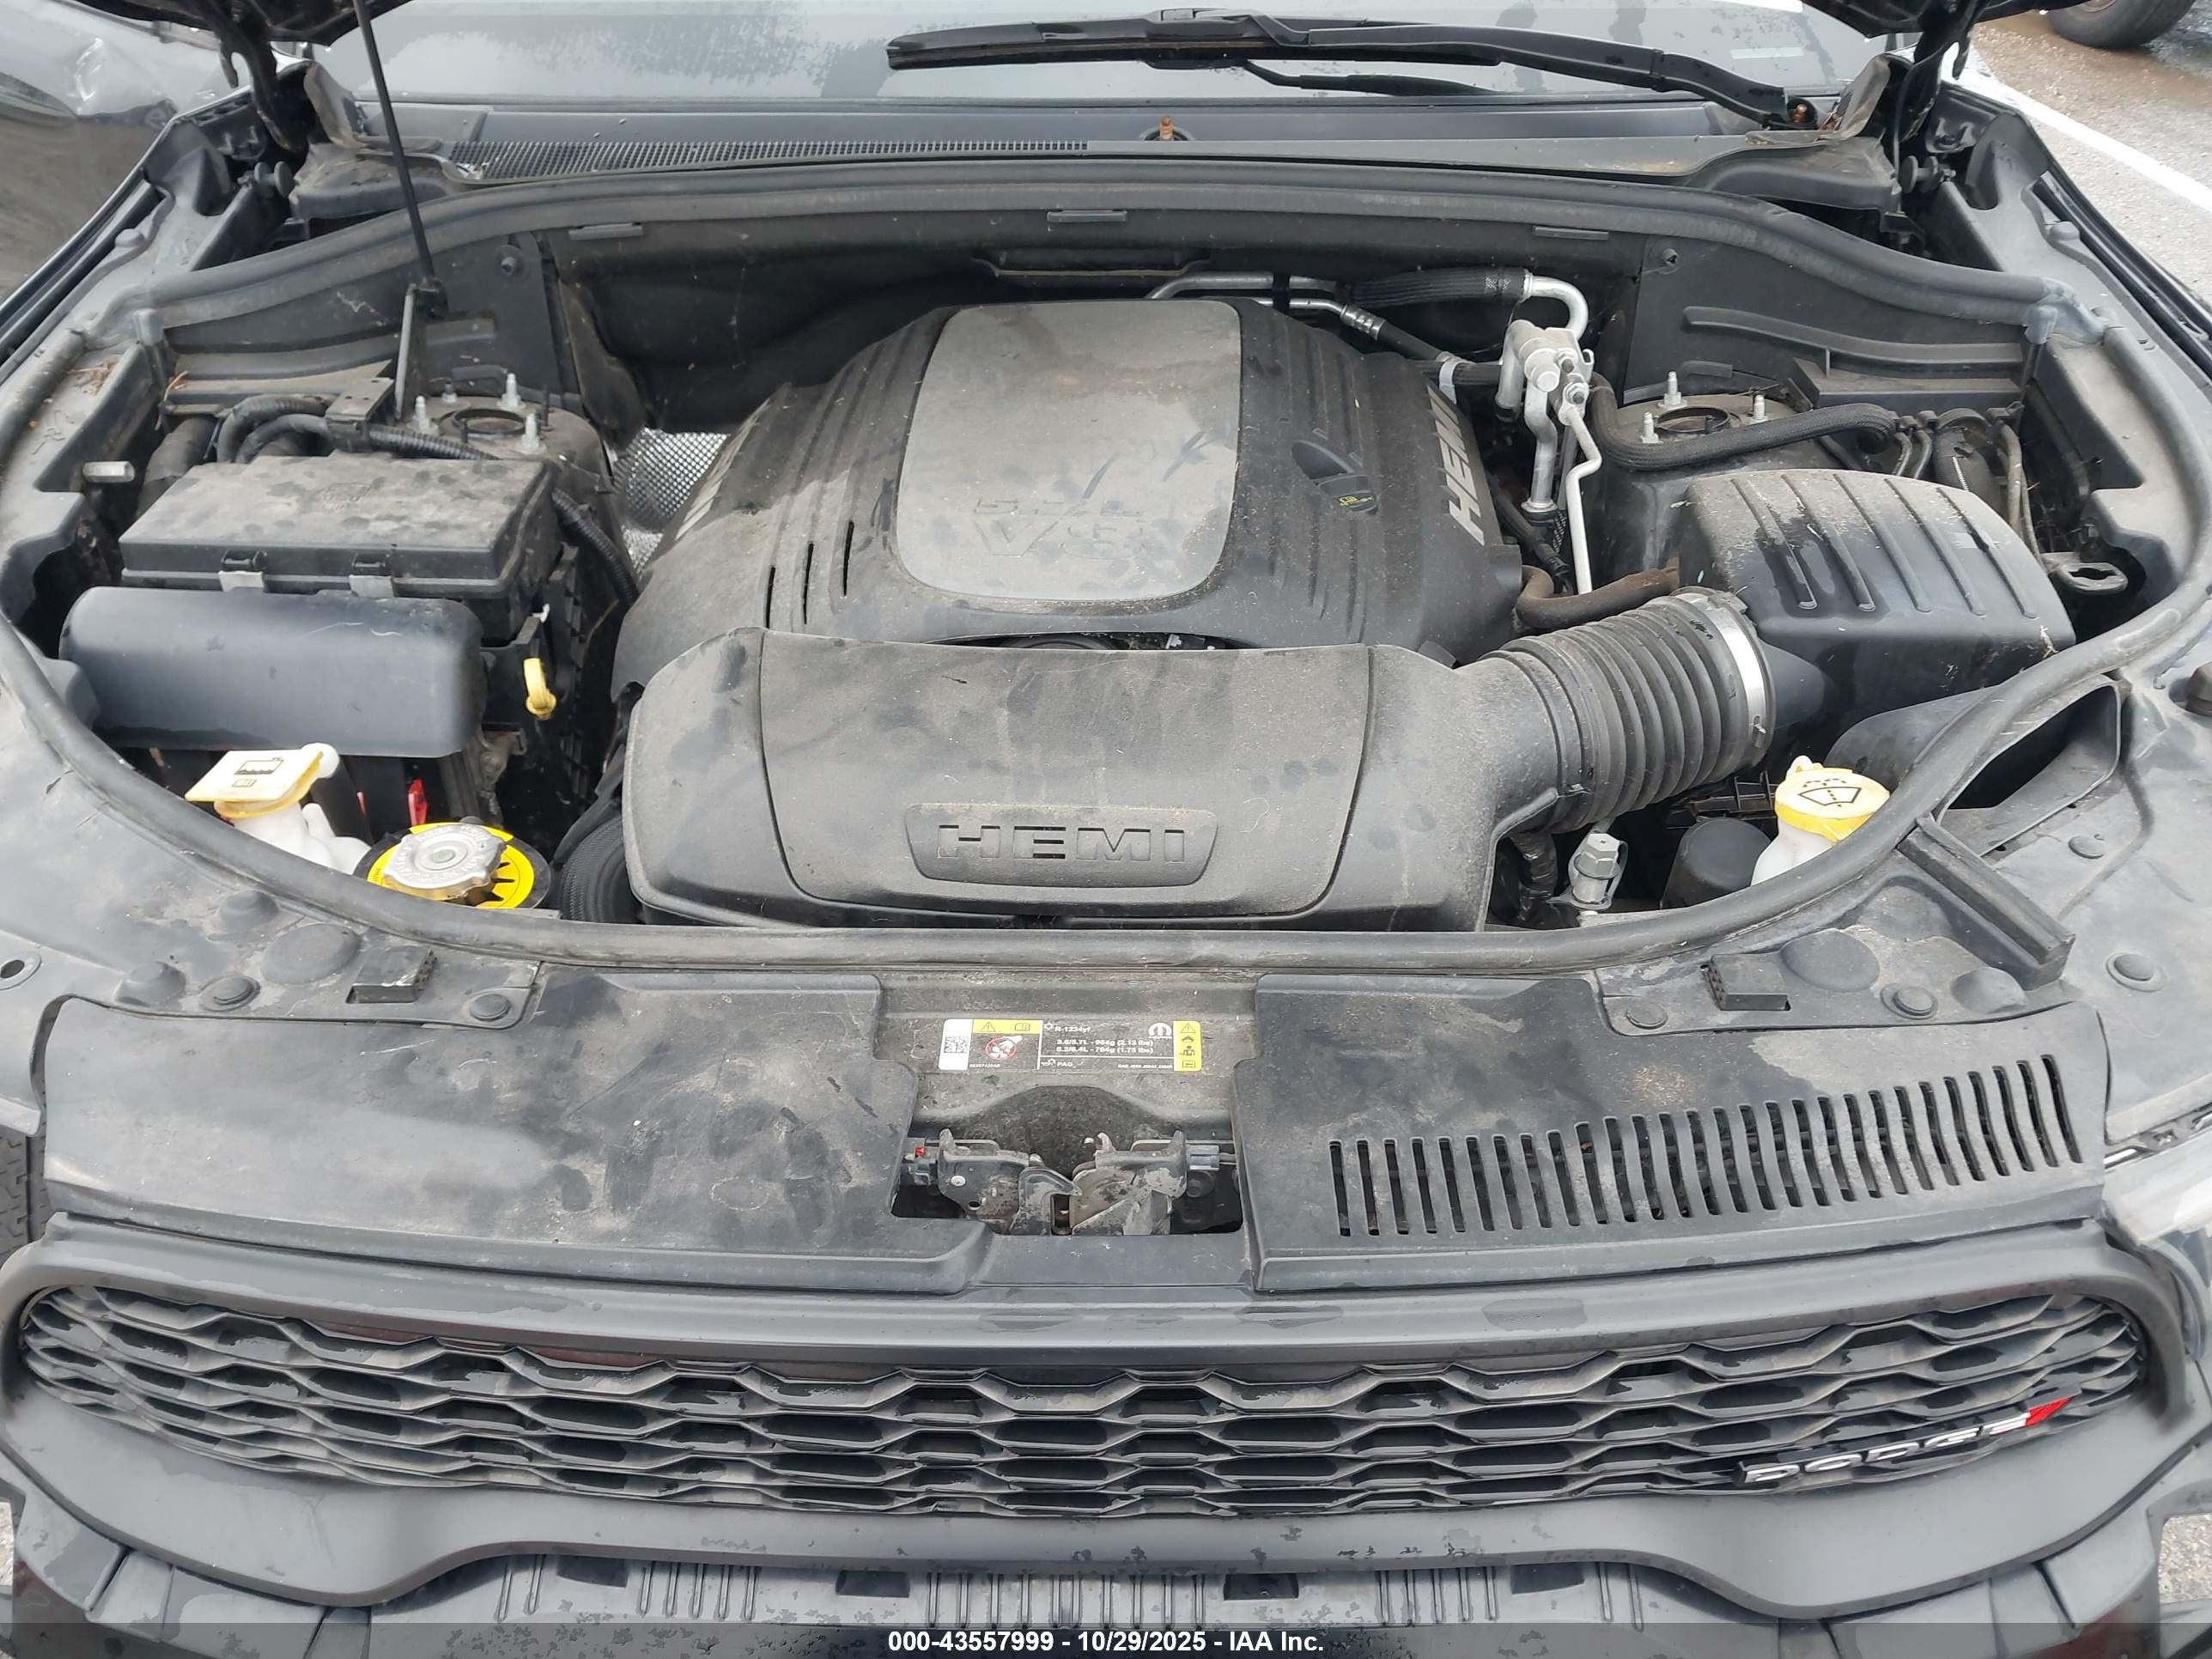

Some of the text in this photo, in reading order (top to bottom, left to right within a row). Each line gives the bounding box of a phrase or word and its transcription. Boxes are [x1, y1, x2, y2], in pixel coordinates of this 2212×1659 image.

[1427, 386, 1485, 546] HEMI
[939, 824, 1185, 861] HEMI
[1743, 1413, 2031, 1484] DODGE
